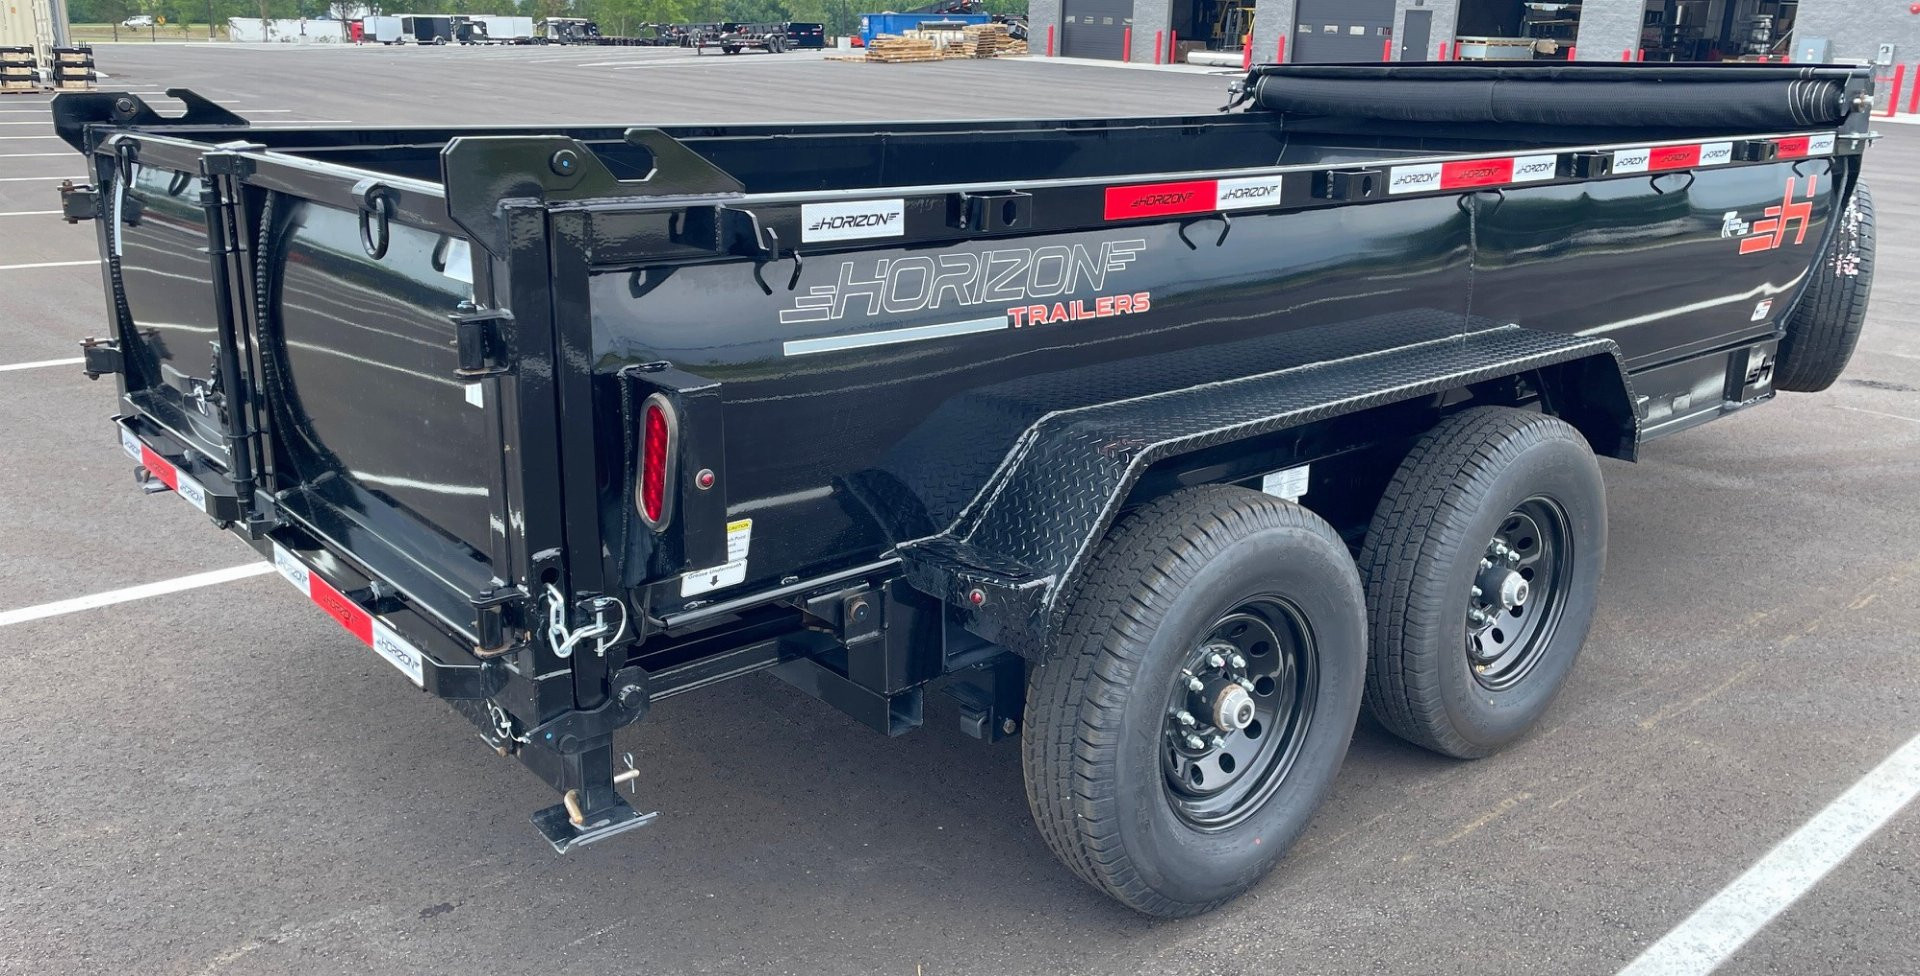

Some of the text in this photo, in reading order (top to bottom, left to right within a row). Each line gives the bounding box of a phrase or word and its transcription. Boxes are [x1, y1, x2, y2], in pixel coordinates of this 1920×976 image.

[1458, 167, 1500, 179] HORIZON
[1515, 162, 1555, 175] HORIZON
[1393, 172, 1440, 185] HORIZON
[1131, 192, 1195, 207] HORIZON
[1221, 185, 1279, 200] HORIZON
[808, 212, 900, 231] HORIZON
[779, 238, 1147, 324] HORIZON
[1007, 292, 1151, 328] TRAILERS
[377, 637, 420, 669] HORIZON
